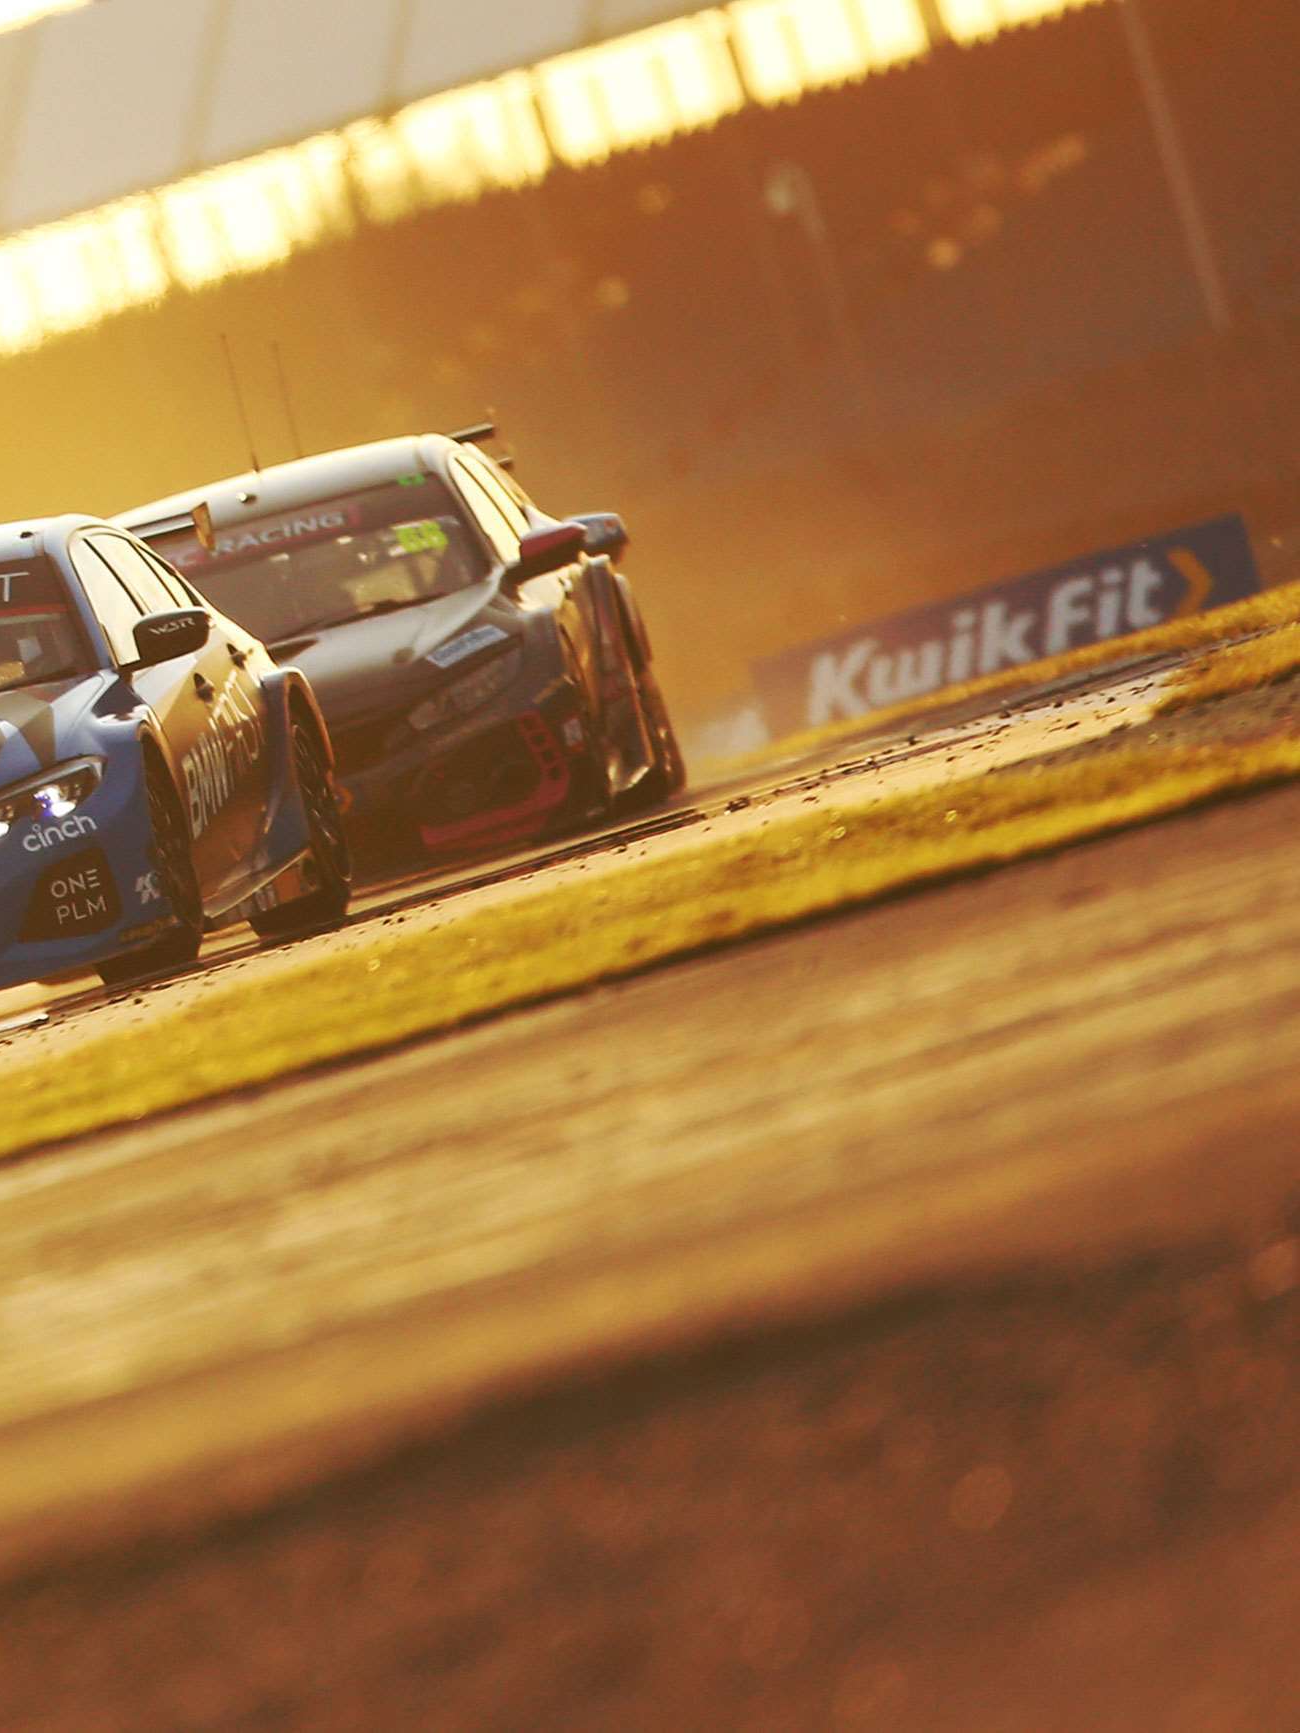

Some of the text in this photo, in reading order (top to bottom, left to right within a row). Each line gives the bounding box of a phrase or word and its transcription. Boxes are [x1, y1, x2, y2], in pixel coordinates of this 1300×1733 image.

[21, 813, 98, 854] cinch
[50, 868, 102, 900] ONE
[55, 894, 108, 926] PLM
